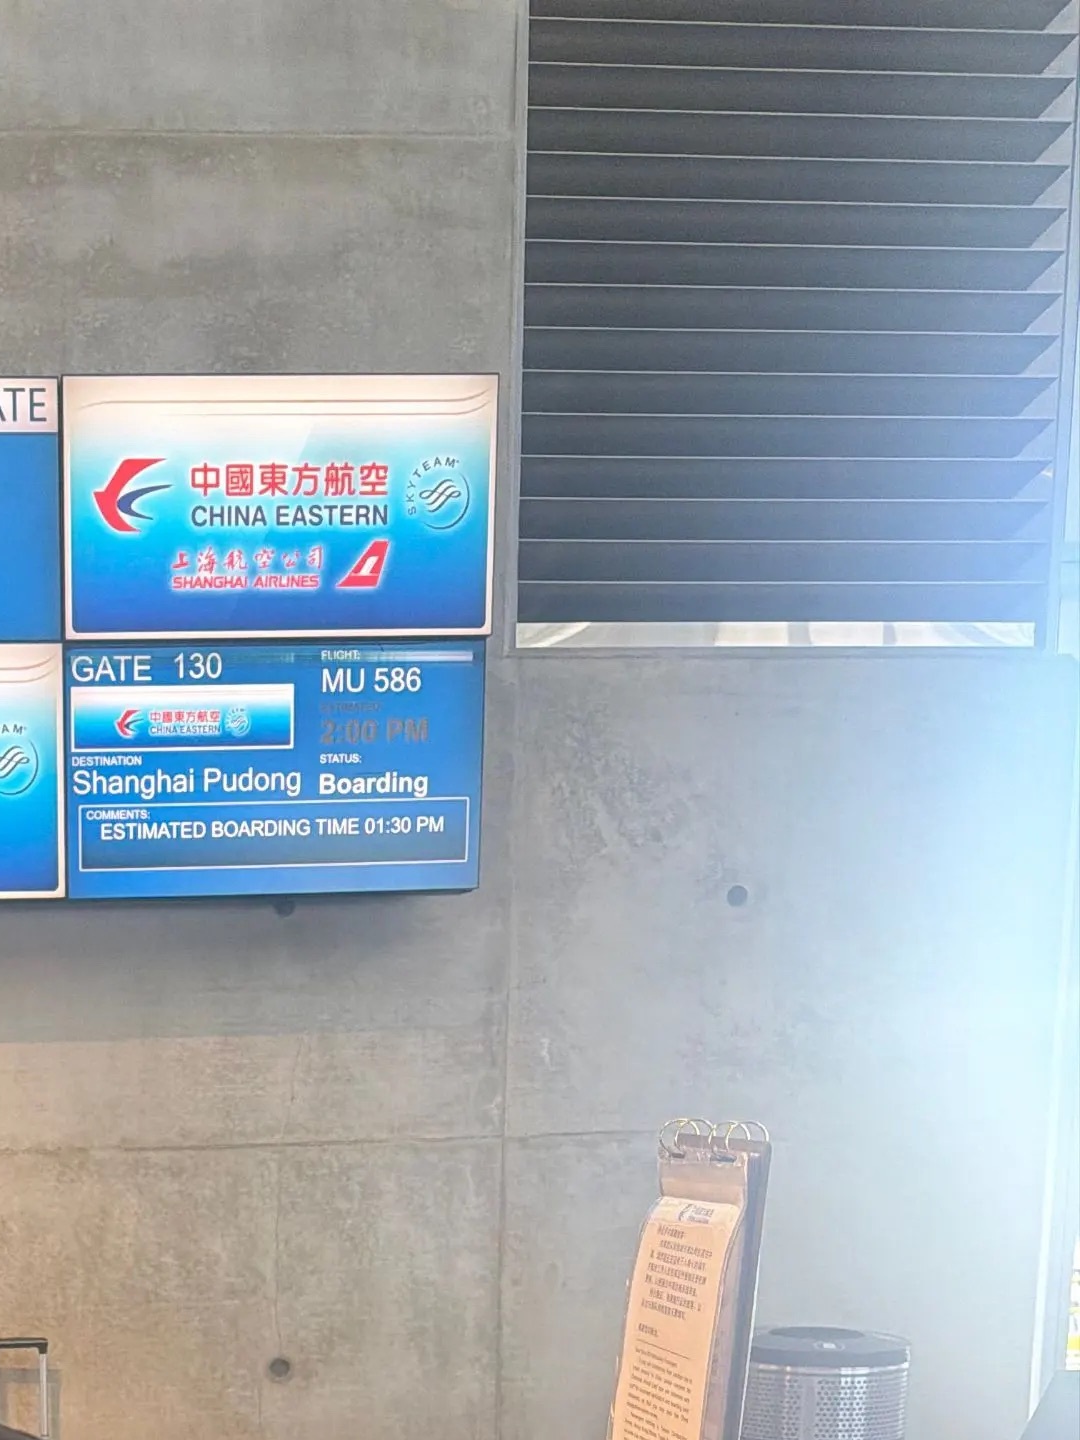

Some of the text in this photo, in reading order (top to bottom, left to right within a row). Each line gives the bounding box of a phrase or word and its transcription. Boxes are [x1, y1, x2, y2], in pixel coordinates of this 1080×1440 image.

[191, 462, 389, 497] 中國東方航空
[406, 456, 456, 516] SKYTEAM
[191, 504, 389, 527] CHINA EASTERN
[172, 545, 323, 574] 上海航空公司
[172, 575, 320, 589] SHANGHAI AIRLINES
[71, 652, 222, 682] GATE 130
[320, 650, 361, 661] FLIGHT:
[321, 666, 422, 693] MU 586
[149, 724, 221, 735] CHINA EASTERN
[321, 715, 429, 744] 2:00 PM
[71, 755, 143, 767] DESTINATION
[319, 753, 362, 765] STATUS:
[72, 766, 302, 800] Shanghai Pudong
[319, 770, 429, 798] Boarding
[86, 809, 151, 820] COMMENTS:
[100, 815, 444, 841] ESTIMATED BOARDING TIME 01:30 PM
